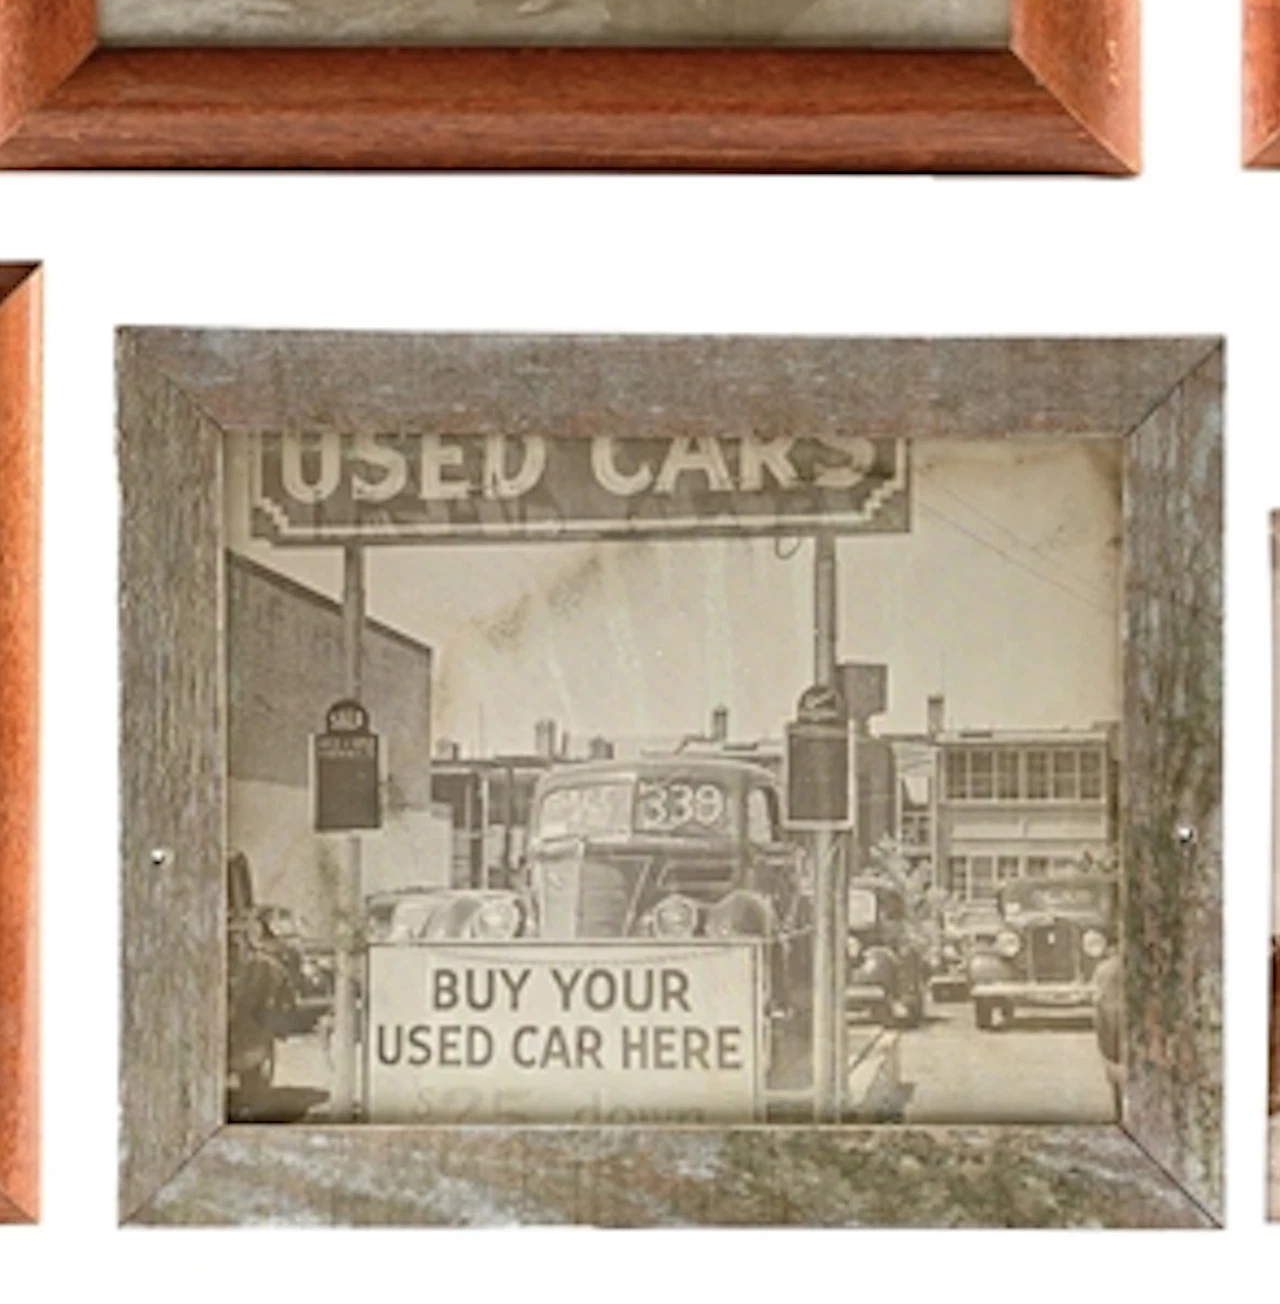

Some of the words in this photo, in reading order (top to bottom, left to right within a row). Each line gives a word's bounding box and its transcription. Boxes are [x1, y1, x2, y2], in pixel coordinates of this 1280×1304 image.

[280, 435, 546, 503] USED
[590, 435, 876, 496] CARS
[433, 968, 532, 1012] BUY
[550, 968, 693, 1013] YOUR
[377, 1023, 495, 1068] USED
[513, 1024, 605, 1070] CAR
[621, 1025, 744, 1071] HERE
